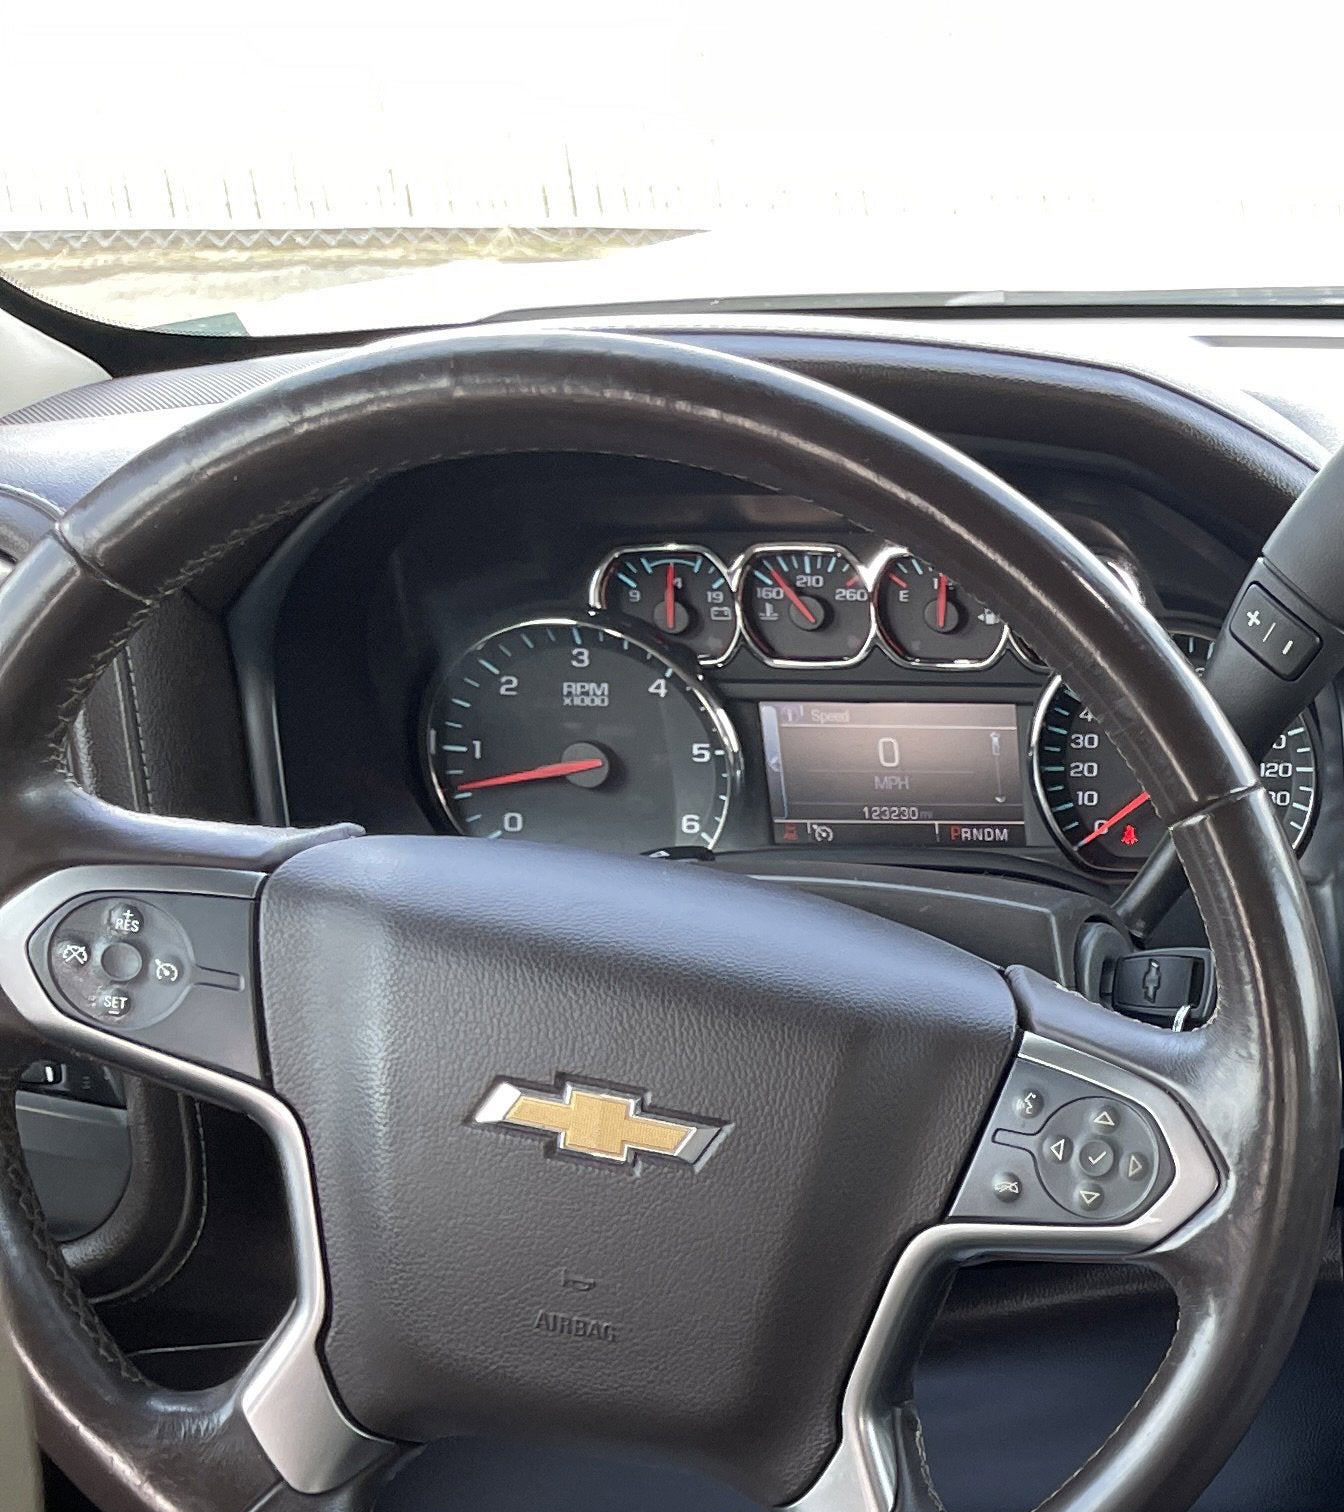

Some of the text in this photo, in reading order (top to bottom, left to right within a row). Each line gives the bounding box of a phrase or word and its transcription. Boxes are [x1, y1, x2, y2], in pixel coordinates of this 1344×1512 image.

[796, 575, 824, 588] 210
[629, 590, 641, 602] 9
[707, 591, 724, 603] 19
[757, 587, 784, 600] 160
[835, 588, 868, 601] 260
[899, 590, 909, 602] E
[571, 648, 590, 667] 3
[500, 676, 519, 695] 2
[563, 682, 609, 696] RPM
[648, 678, 667, 697] 4
[811, 709, 849, 723] Speed
[1070, 734, 1099, 749] 30
[472, 740, 482, 759] 1
[692, 743, 710, 762] 5
[878, 737, 900, 767] 0
[1070, 762, 1098, 777] 20
[1260, 762, 1293, 778] 120
[874, 776, 909, 790] MPH
[1077, 791, 1098, 806] 10
[863, 806, 919, 820] 123230
[503, 812, 523, 831] 0
[681, 814, 700, 833] 6
[951, 826, 1009, 842] PRNDM
[115, 919, 139, 933] RES
[103, 996, 128, 1009] SET
[535, 1310, 616, 1342] AIRBAG
